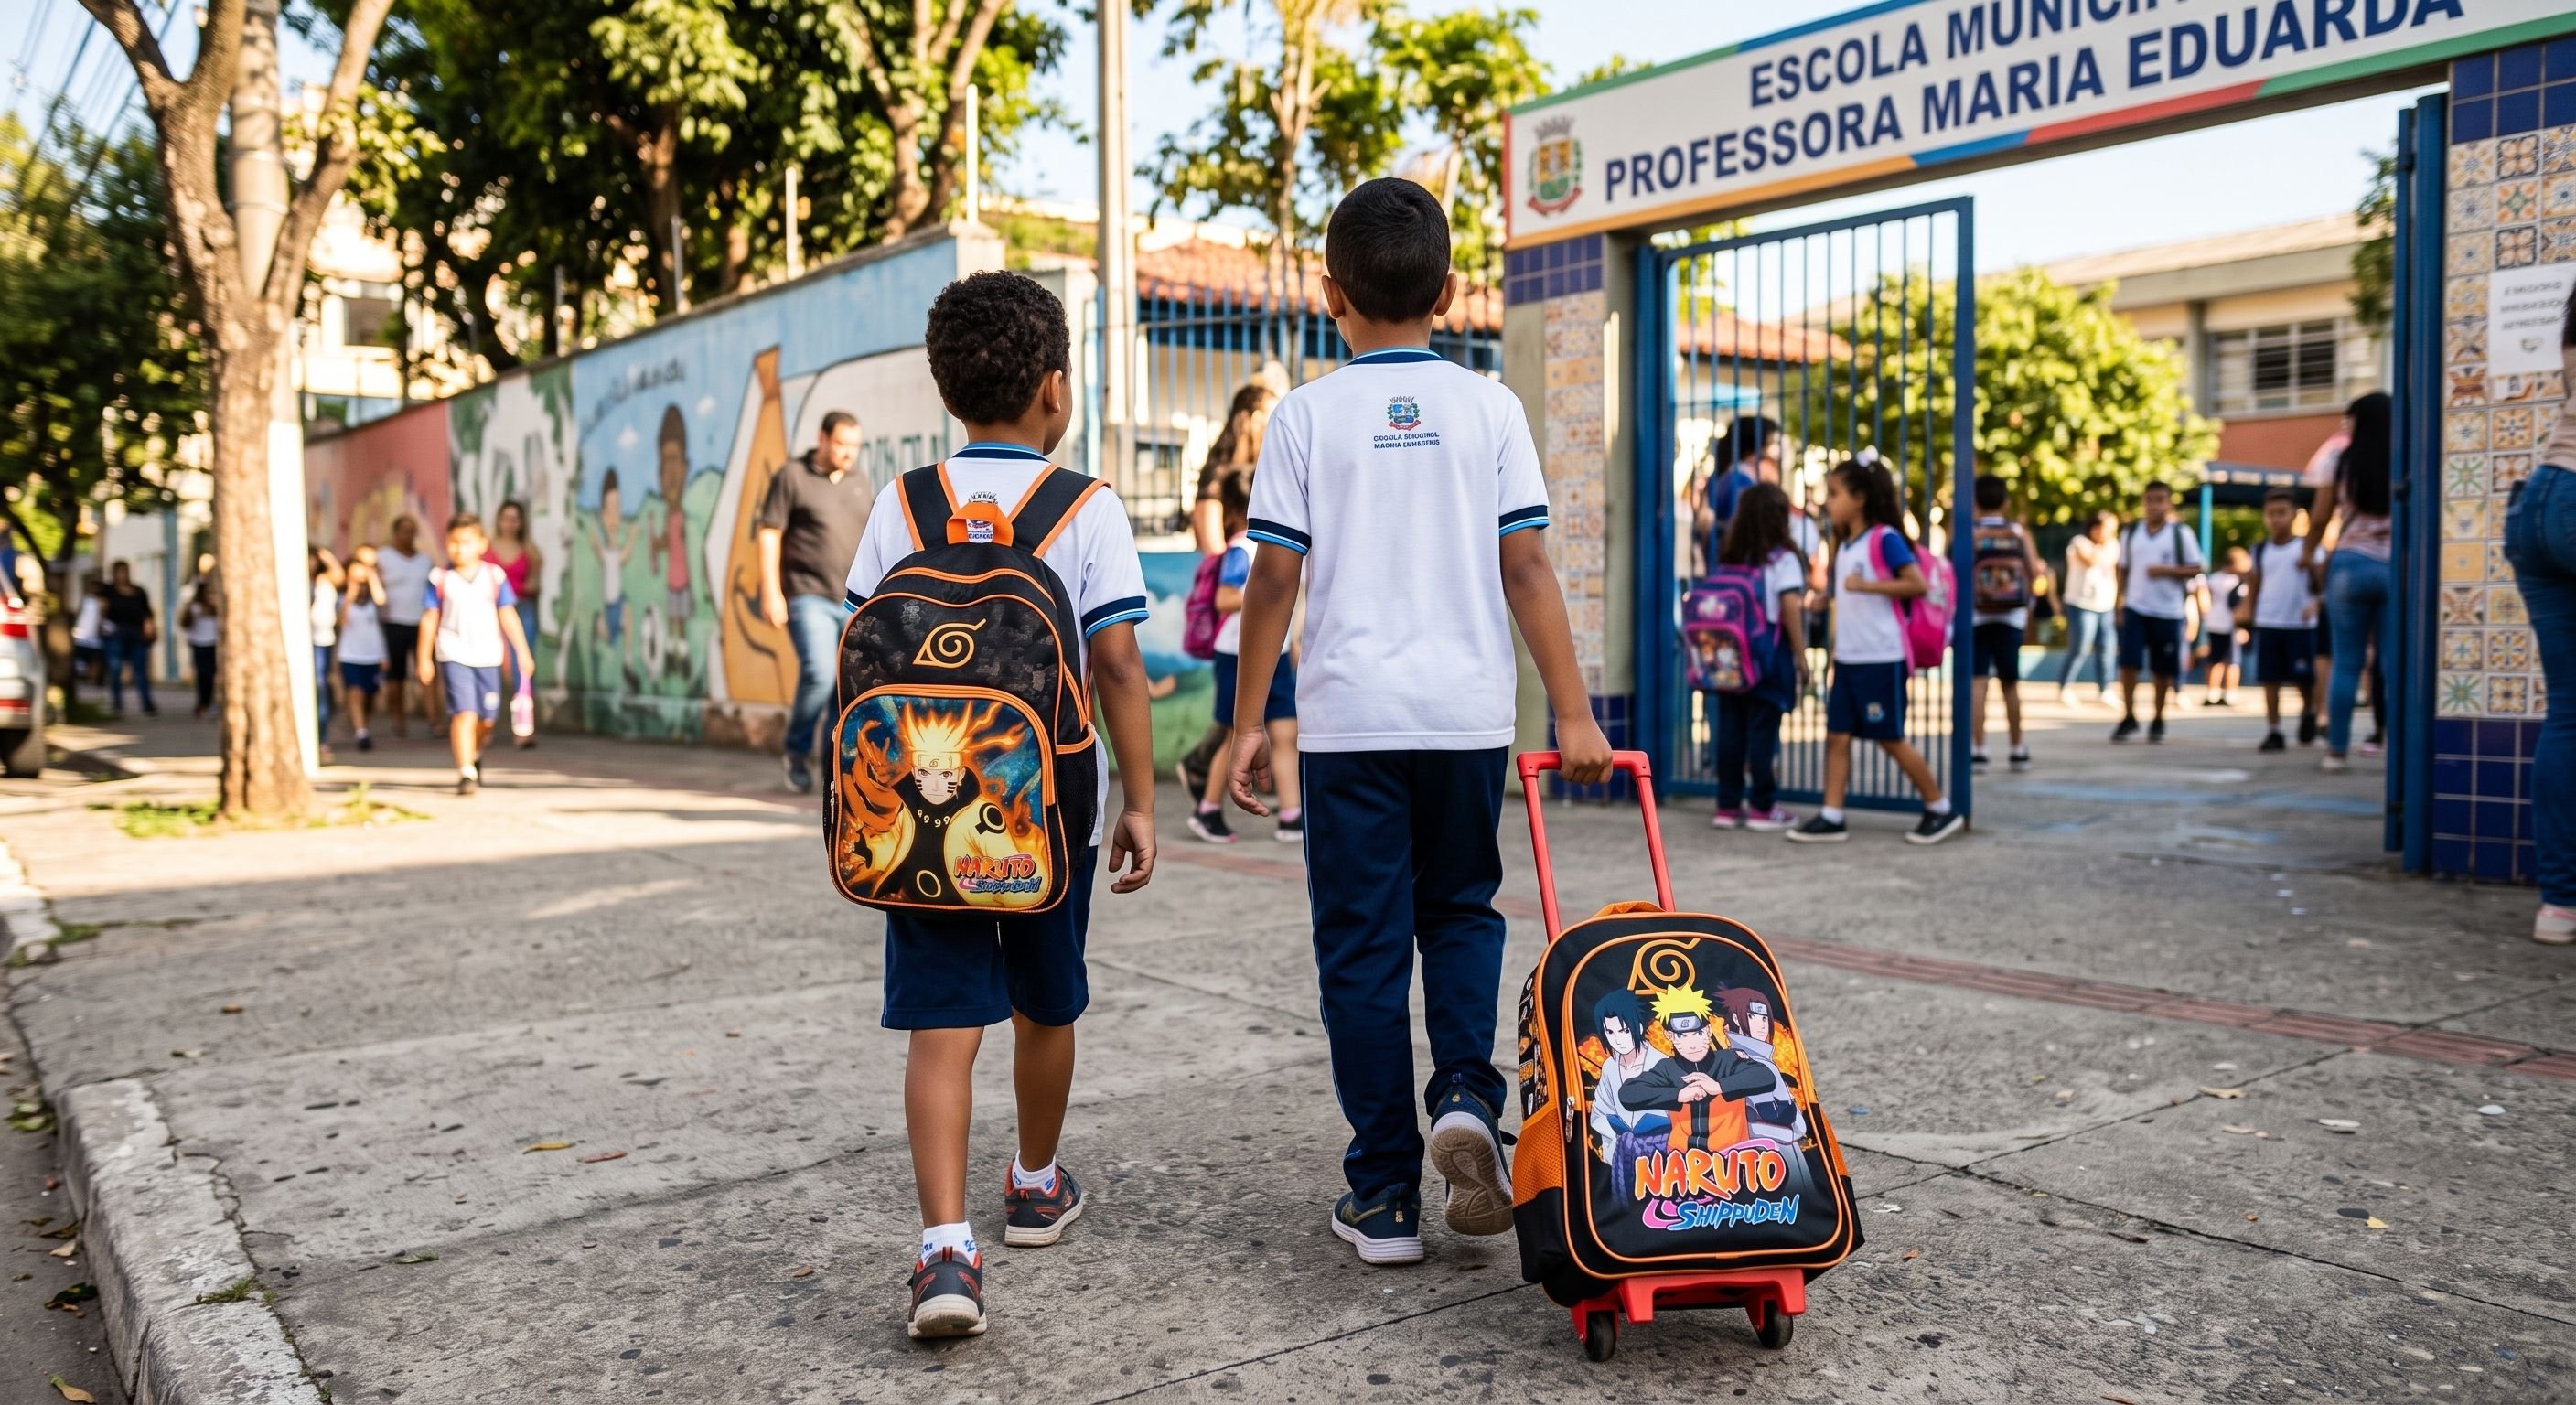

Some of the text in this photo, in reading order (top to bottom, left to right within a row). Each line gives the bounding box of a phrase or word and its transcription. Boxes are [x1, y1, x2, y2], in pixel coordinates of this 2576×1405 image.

[1751, 21, 1928, 108] ESCOLA
[1605, 95, 1902, 201] PROFESSORA
[1922, 46, 2105, 134] MARIA
[954, 854, 1036, 880] NARUTO
[1635, 1148, 1786, 1200] NARUTO
[1667, 1194, 1800, 1231] SHIPPUDEN
